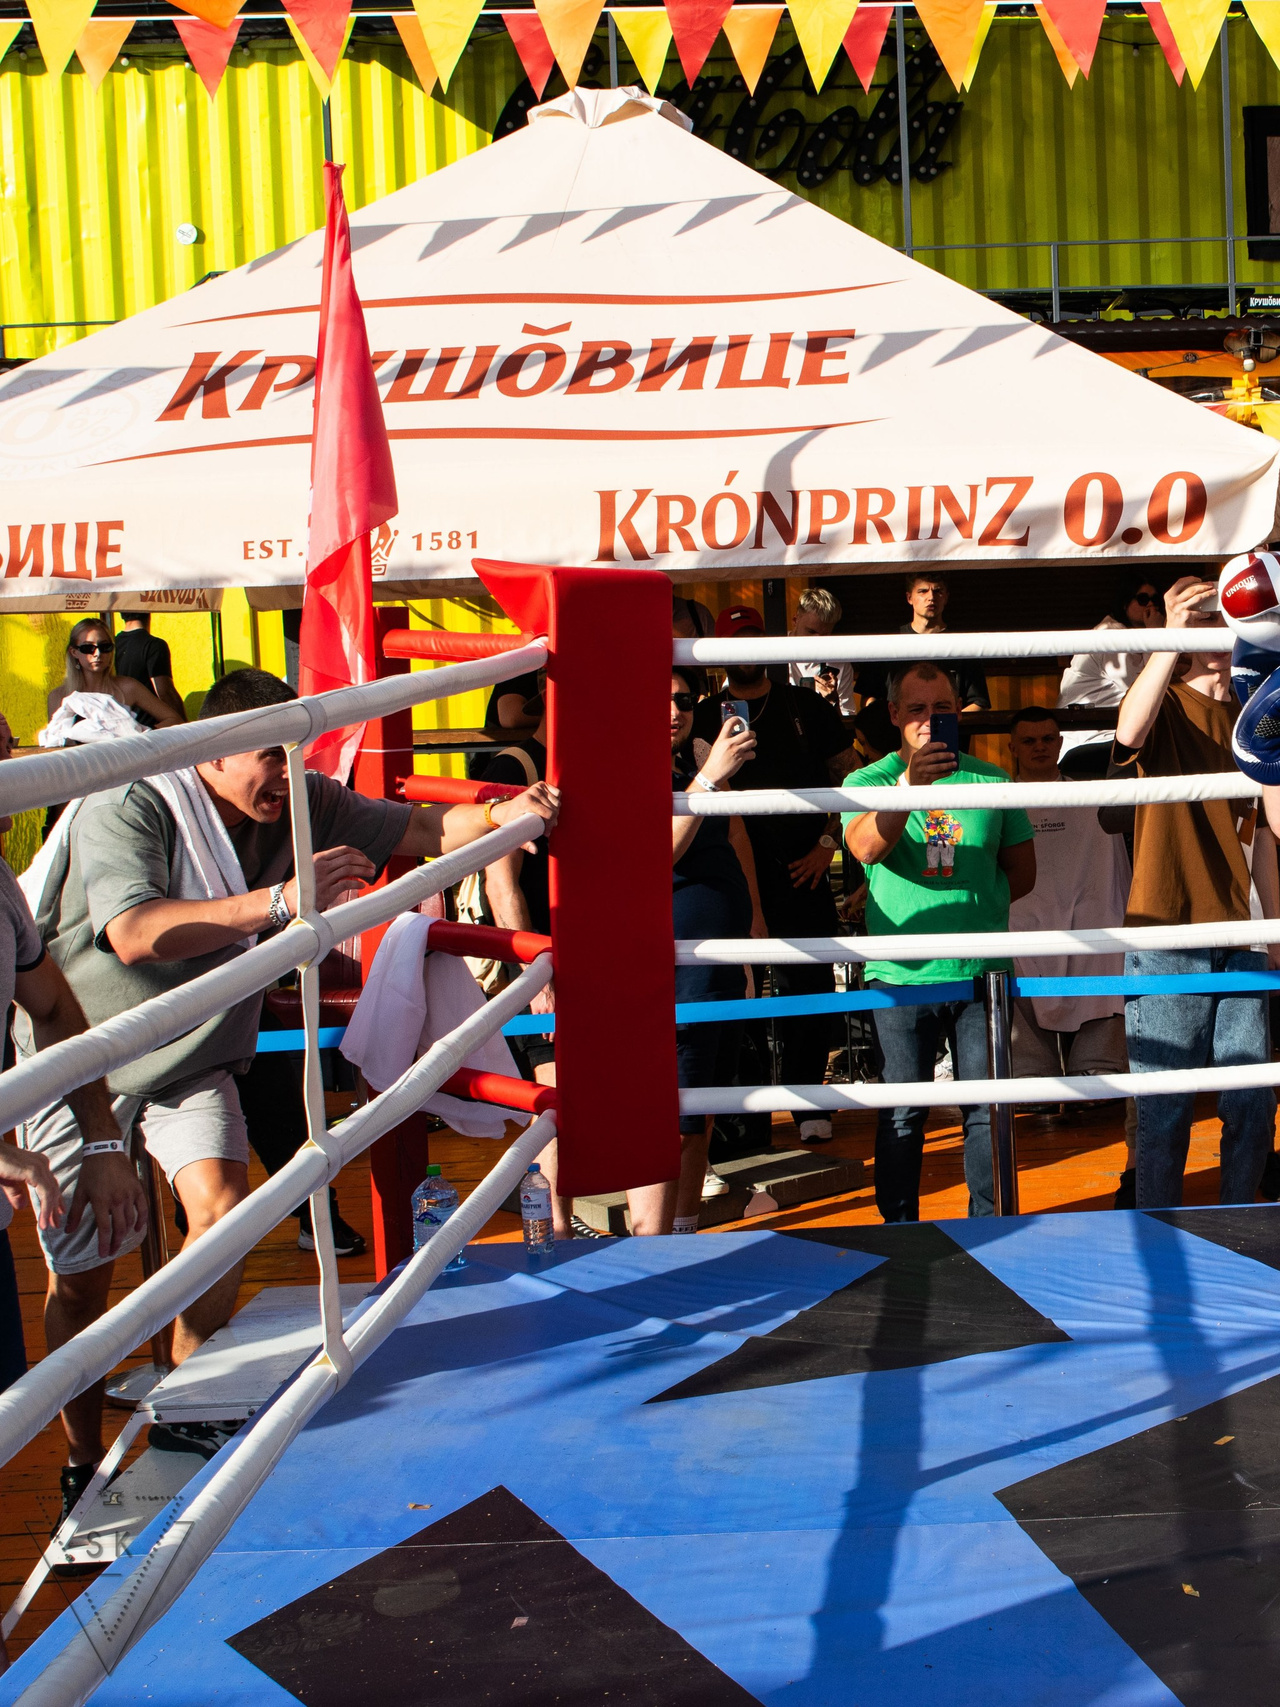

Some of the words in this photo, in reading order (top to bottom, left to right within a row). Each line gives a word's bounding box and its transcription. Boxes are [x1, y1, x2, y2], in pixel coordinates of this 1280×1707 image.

[591, 470, 1034, 563] KRÓNPRINZ
[1063, 471, 1208, 547] 0.0
[243, 539, 303, 560] EST.
[412, 530, 478, 551] 1581
[1225, 575, 1256, 598] UNIQUE
